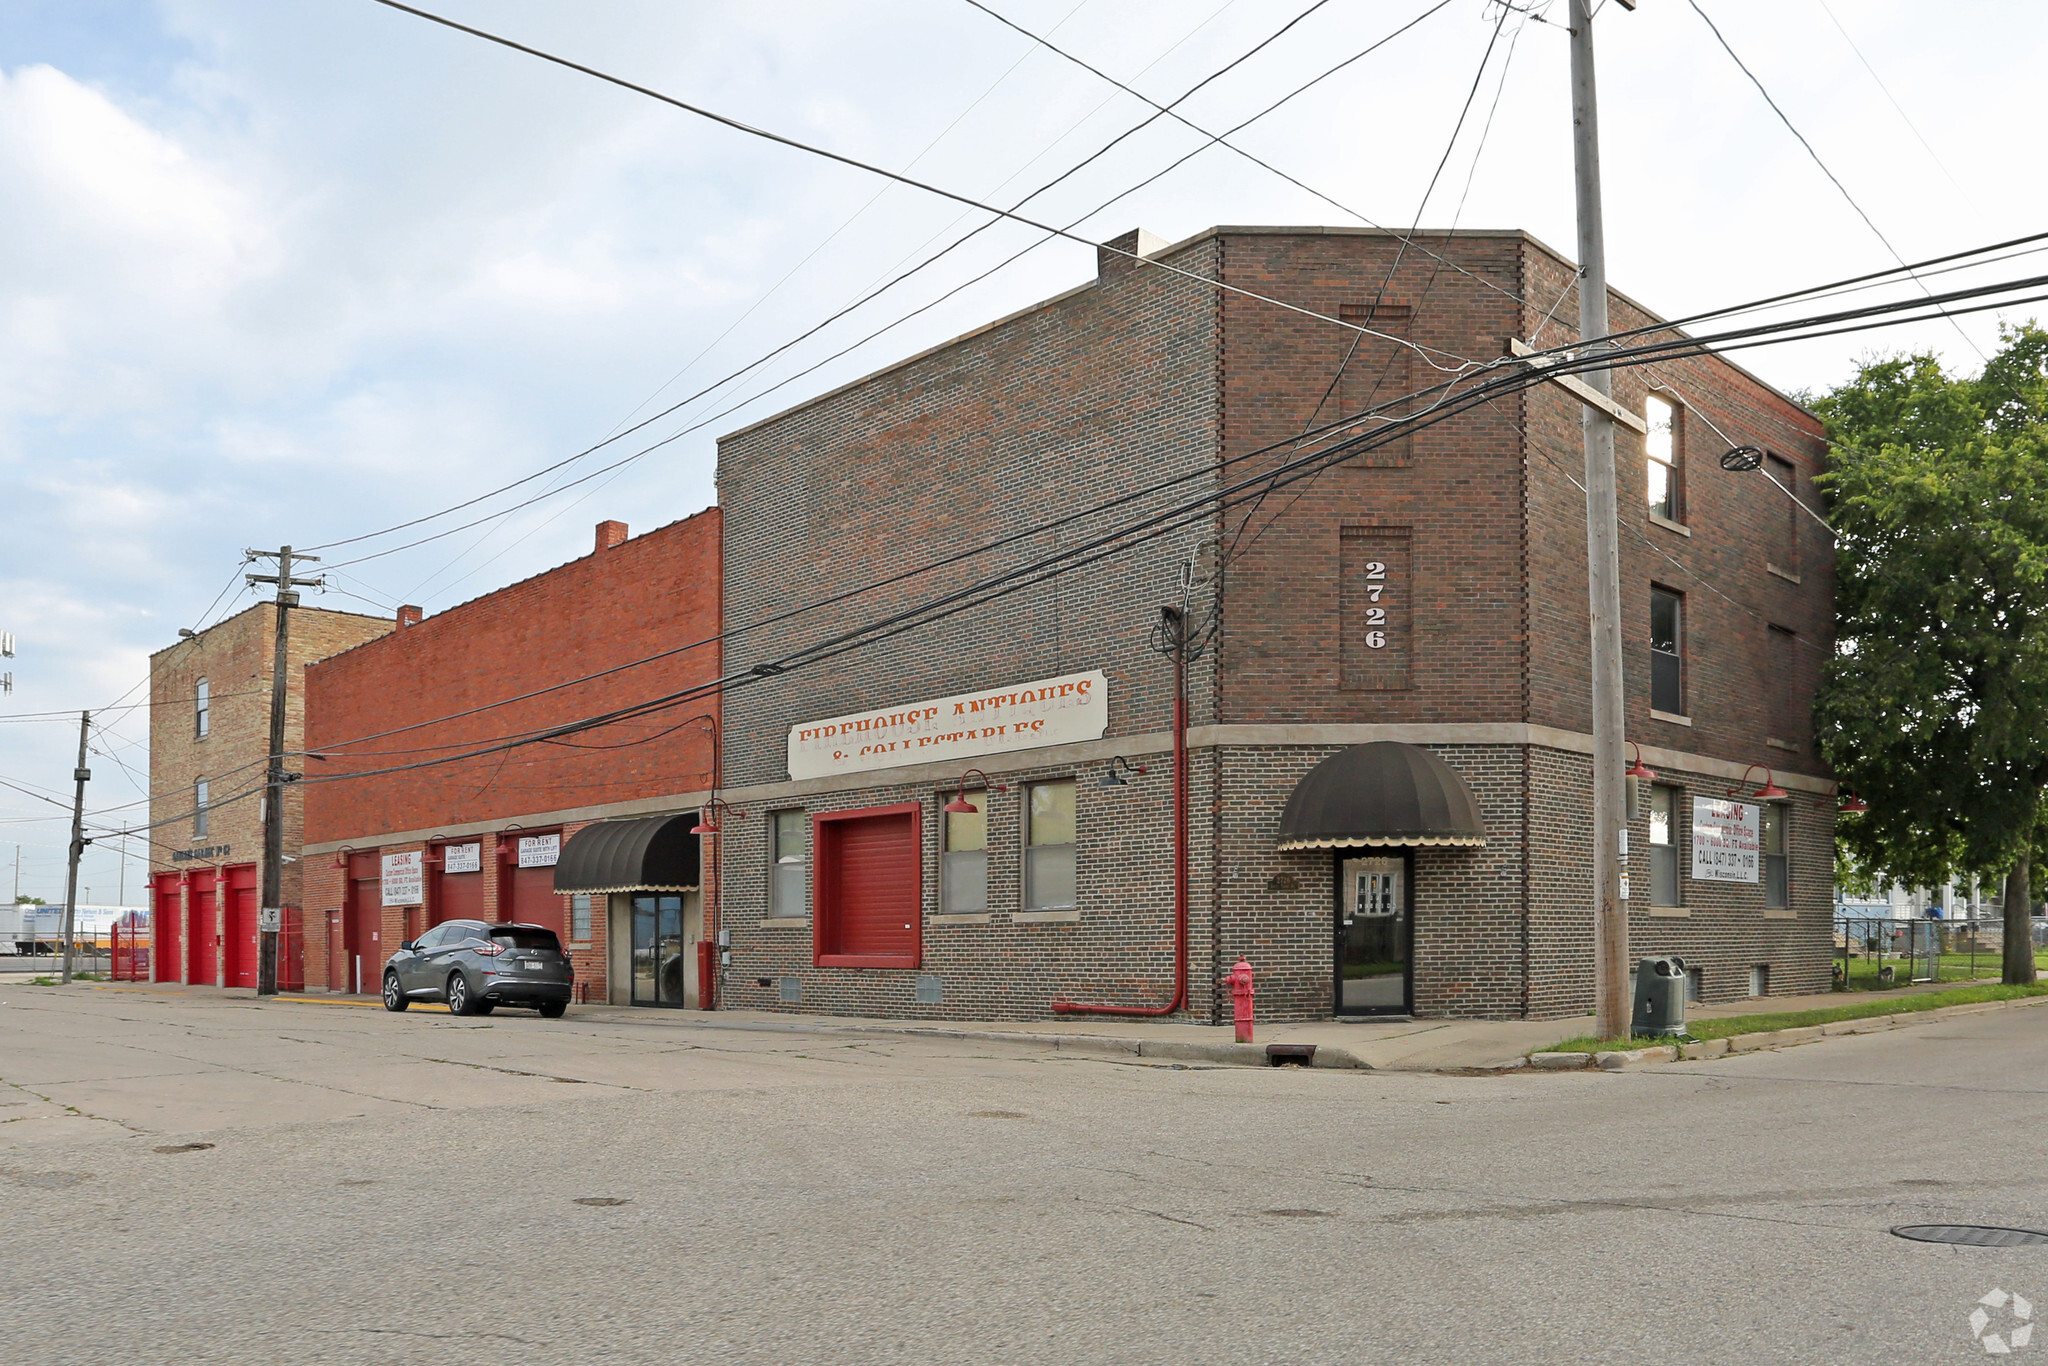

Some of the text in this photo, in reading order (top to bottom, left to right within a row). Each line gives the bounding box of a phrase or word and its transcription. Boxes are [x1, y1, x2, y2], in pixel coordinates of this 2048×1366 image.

[1366, 562, 1386, 648] 2726
[1712, 800, 1744, 821] LEASING
[525, 838, 552, 847] FOR RENT
[1739, 841, 1759, 851] Available
[461, 846, 473, 854] RENT
[392, 854, 411, 866] LEASING
[520, 854, 557, 864] 847-337-0166
[1361, 857, 1388, 866] 2726
[1699, 850, 1713, 865] CALL
[1714, 852, 1727, 867] (847)
[1728, 853, 1737, 867] 337
[1743, 854, 1754, 868] 0166
[447, 861, 478, 870] 847-337-0166
[385, 887, 393, 896] CALL
